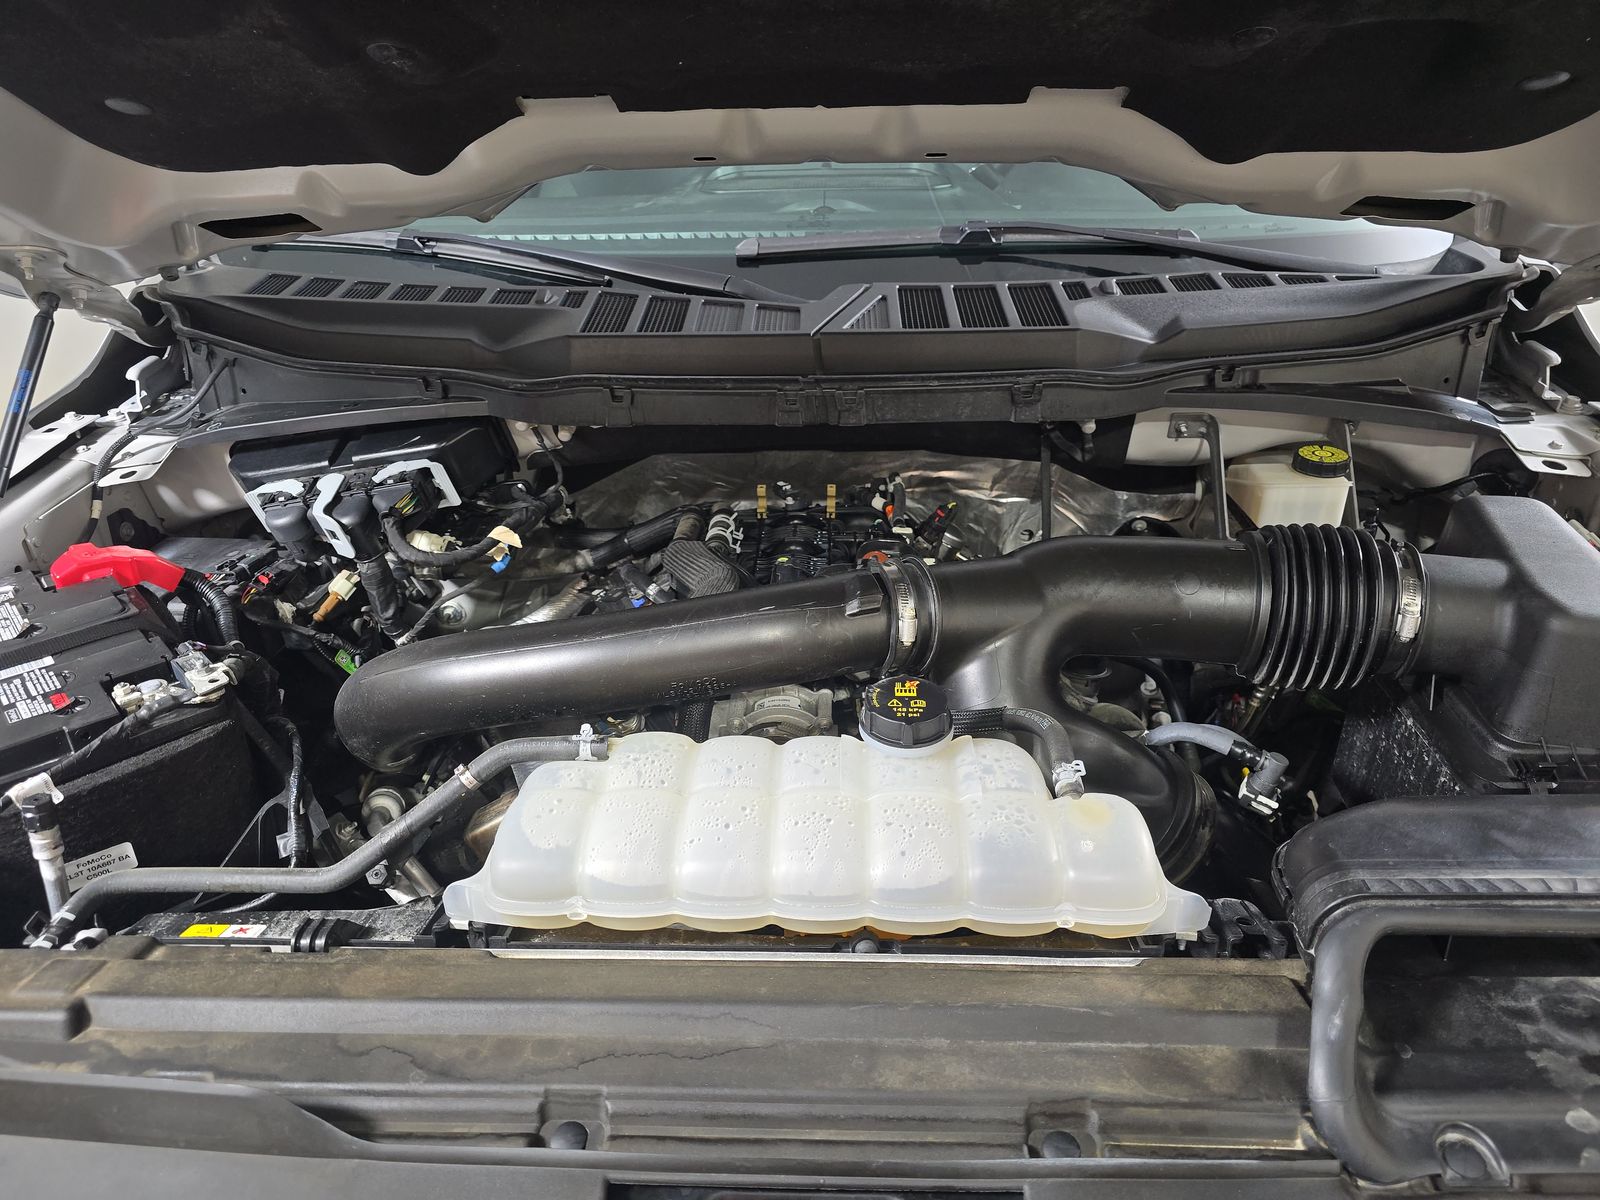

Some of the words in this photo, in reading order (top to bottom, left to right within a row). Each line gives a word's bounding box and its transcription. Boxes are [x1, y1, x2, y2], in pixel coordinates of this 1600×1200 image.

[76, 853, 112, 869] FoMoCo
[118, 854, 131, 862] BA
[86, 868, 113, 881] C500L
